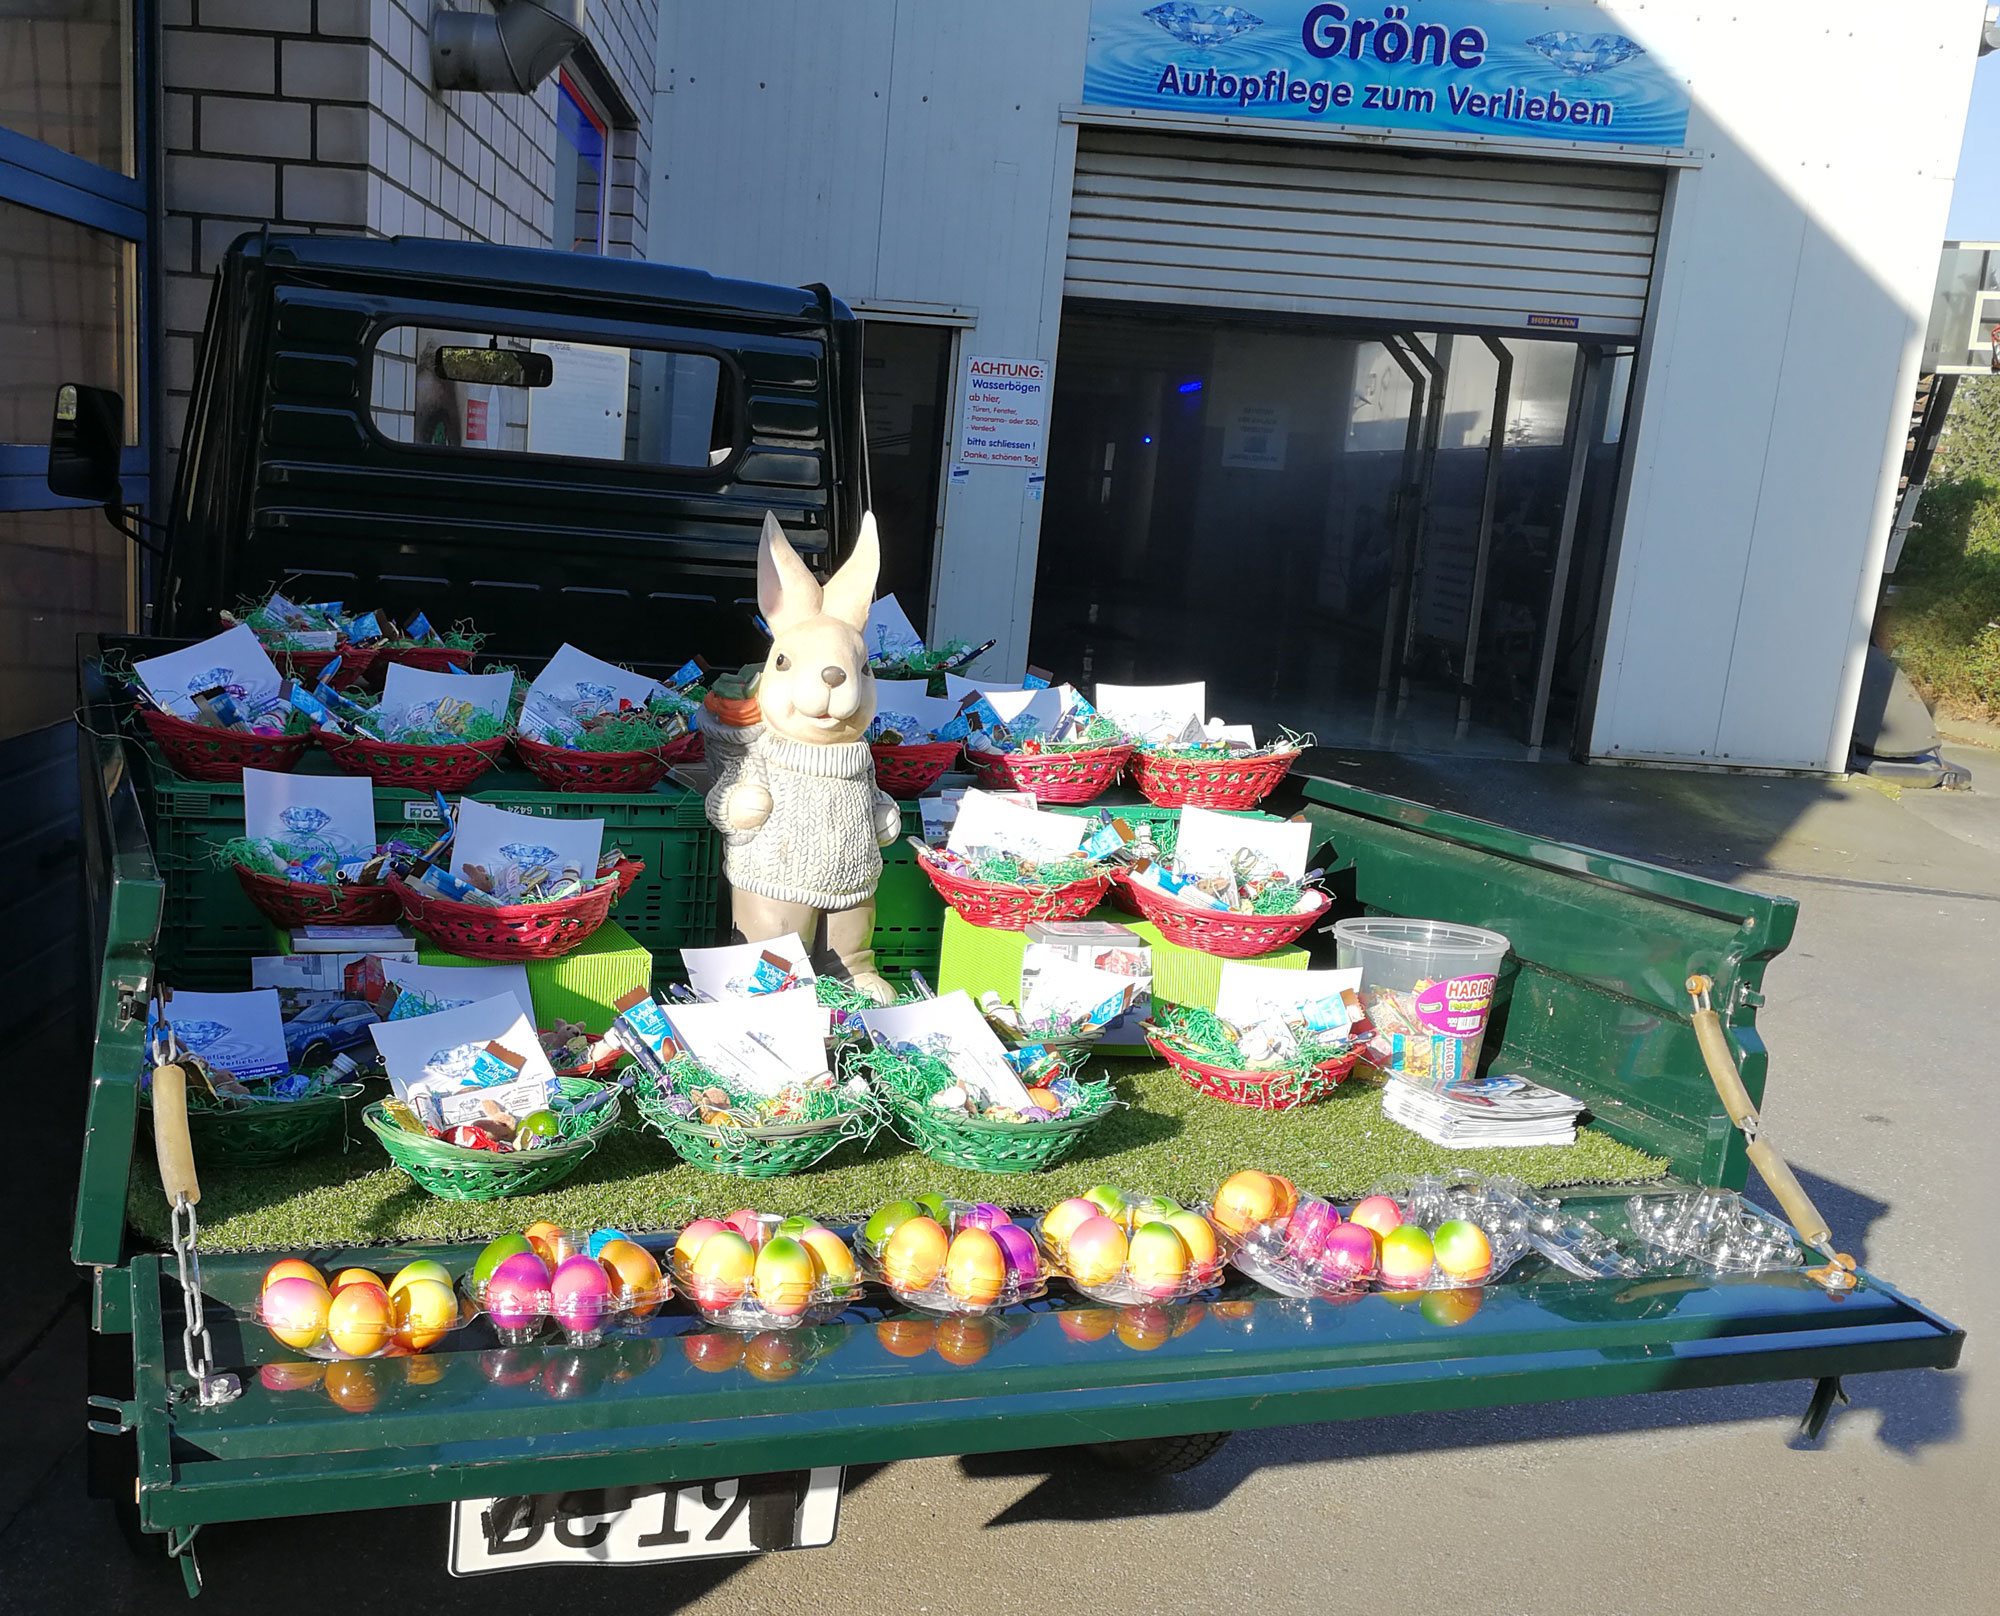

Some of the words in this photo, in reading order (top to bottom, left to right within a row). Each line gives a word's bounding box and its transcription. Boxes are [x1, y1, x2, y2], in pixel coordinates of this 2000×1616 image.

[1302, 3, 1488, 69] Gröne
[1157, 62, 1352, 112] Autopflege
[1363, 84, 1435, 114] zum
[1448, 85, 1613, 126] Verlieben
[970, 361, 1044, 379] ACHTUNG:
[972, 379, 1041, 394] Wasserbögen
[969, 394, 981, 402] ab
[967, 437, 987, 446] bitte
[988, 439, 1031, 450] schliessen
[1445, 1038, 1455, 1080] HARIBO
